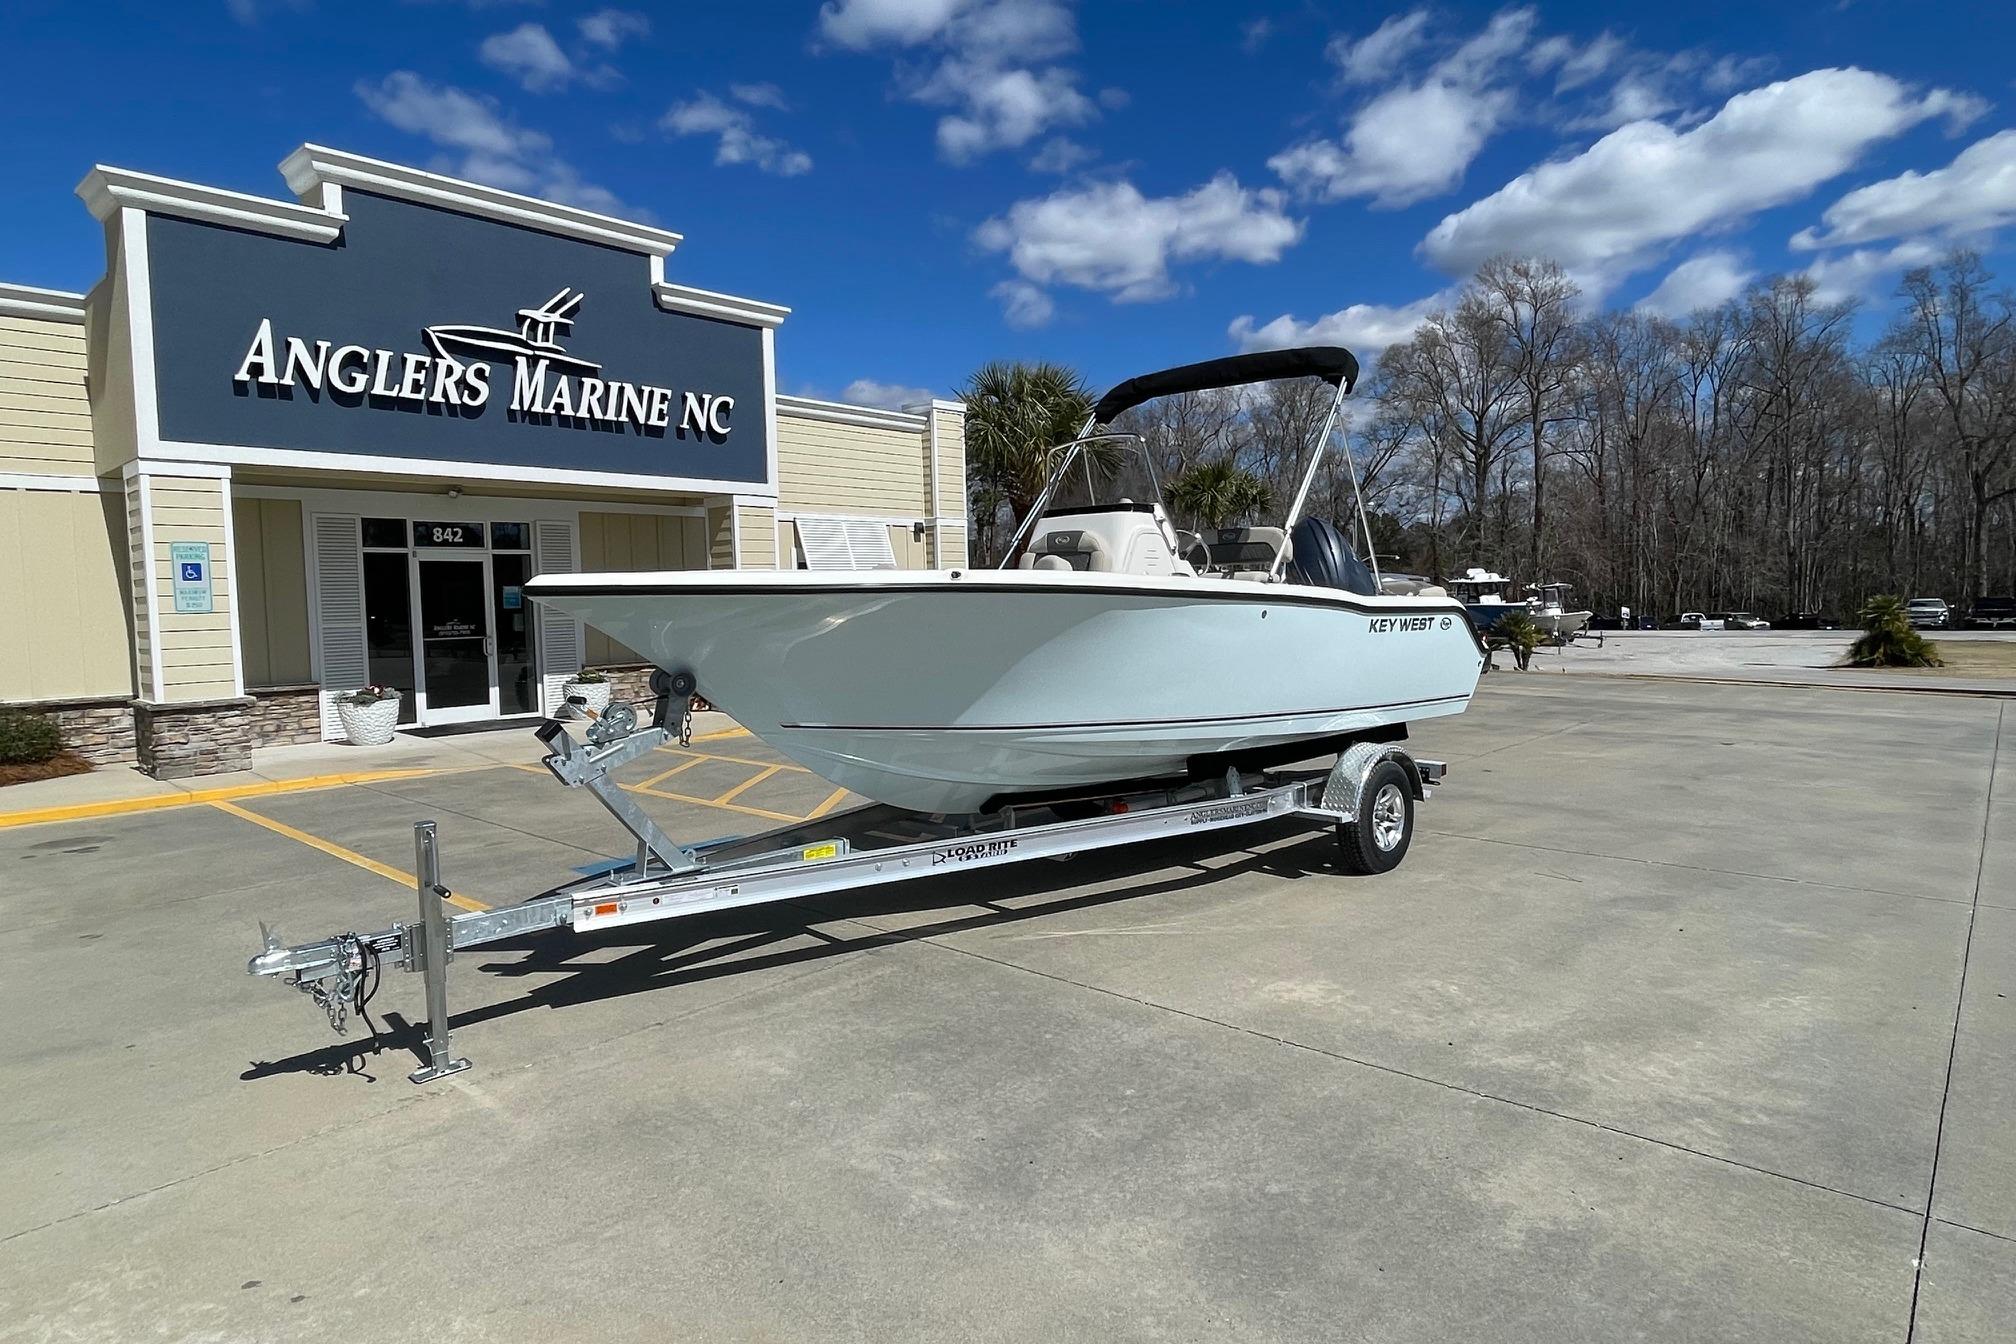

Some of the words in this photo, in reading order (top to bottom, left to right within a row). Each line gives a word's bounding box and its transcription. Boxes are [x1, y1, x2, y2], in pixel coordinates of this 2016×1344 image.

[234, 317, 491, 407] ANGLERS
[510, 355, 672, 427] MARINE
[679, 391, 735, 435] NC
[432, 527, 463, 543] 842
[1368, 618, 1397, 634] KEY
[1399, 616, 1435, 632] WEST
[947, 844, 986, 858] LOAD
[988, 839, 1018, 851] RITE
